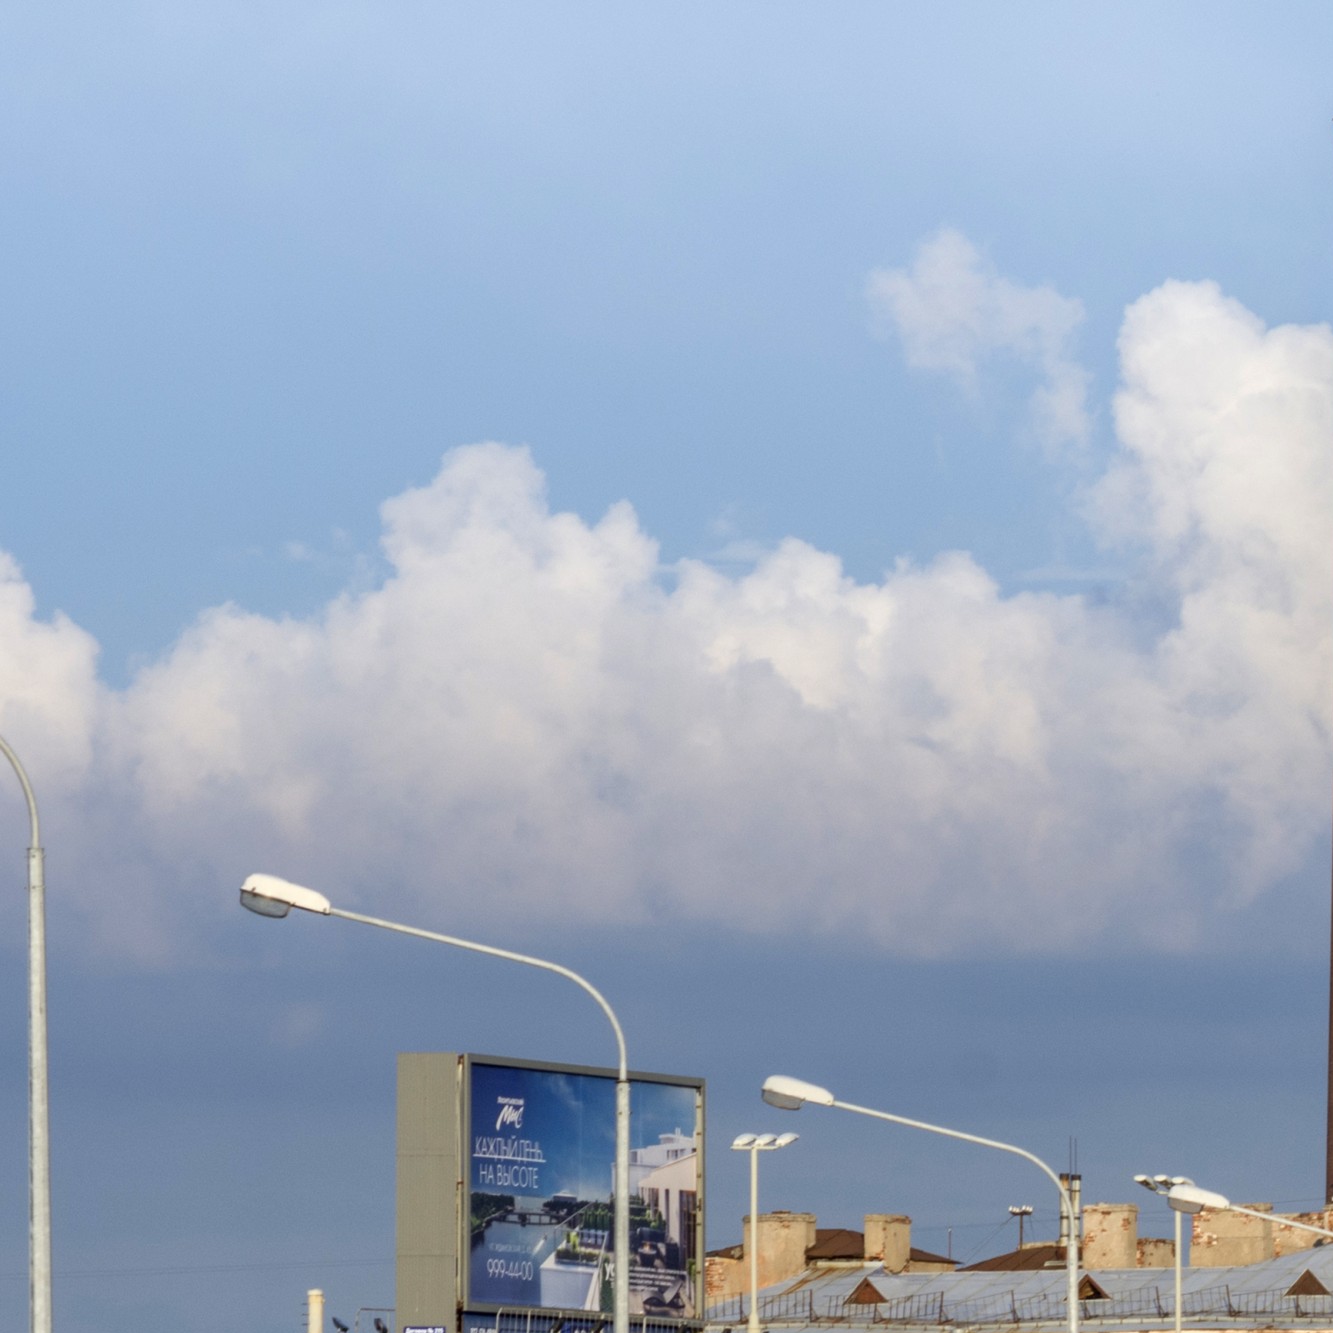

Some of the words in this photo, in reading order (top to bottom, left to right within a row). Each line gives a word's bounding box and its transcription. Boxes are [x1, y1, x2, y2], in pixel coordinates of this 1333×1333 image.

[475, 1135, 517, 1162] КАЖДЫЙ
[518, 1139, 544, 1164] ДЕНЬ
[480, 1164, 495, 1185] НА
[497, 1164, 539, 1188] ВЫСОТЕ
[487, 1258, 533, 1281] 999-44-00
